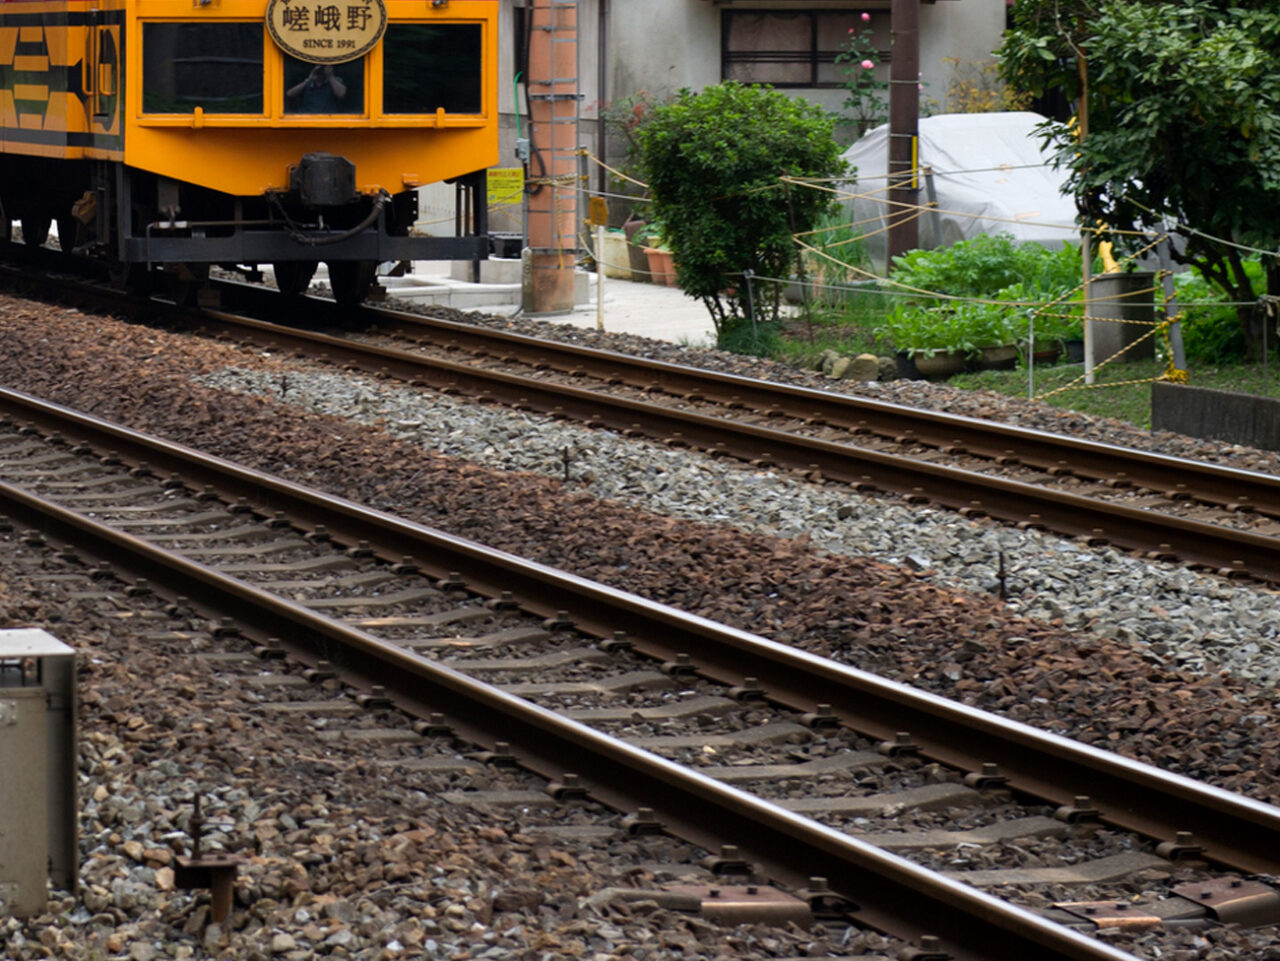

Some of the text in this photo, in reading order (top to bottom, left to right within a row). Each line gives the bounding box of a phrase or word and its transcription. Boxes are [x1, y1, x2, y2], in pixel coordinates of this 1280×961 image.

[282, 4, 373, 32] 嵯峨野
[303, 40, 356, 49] SINCE 1991
